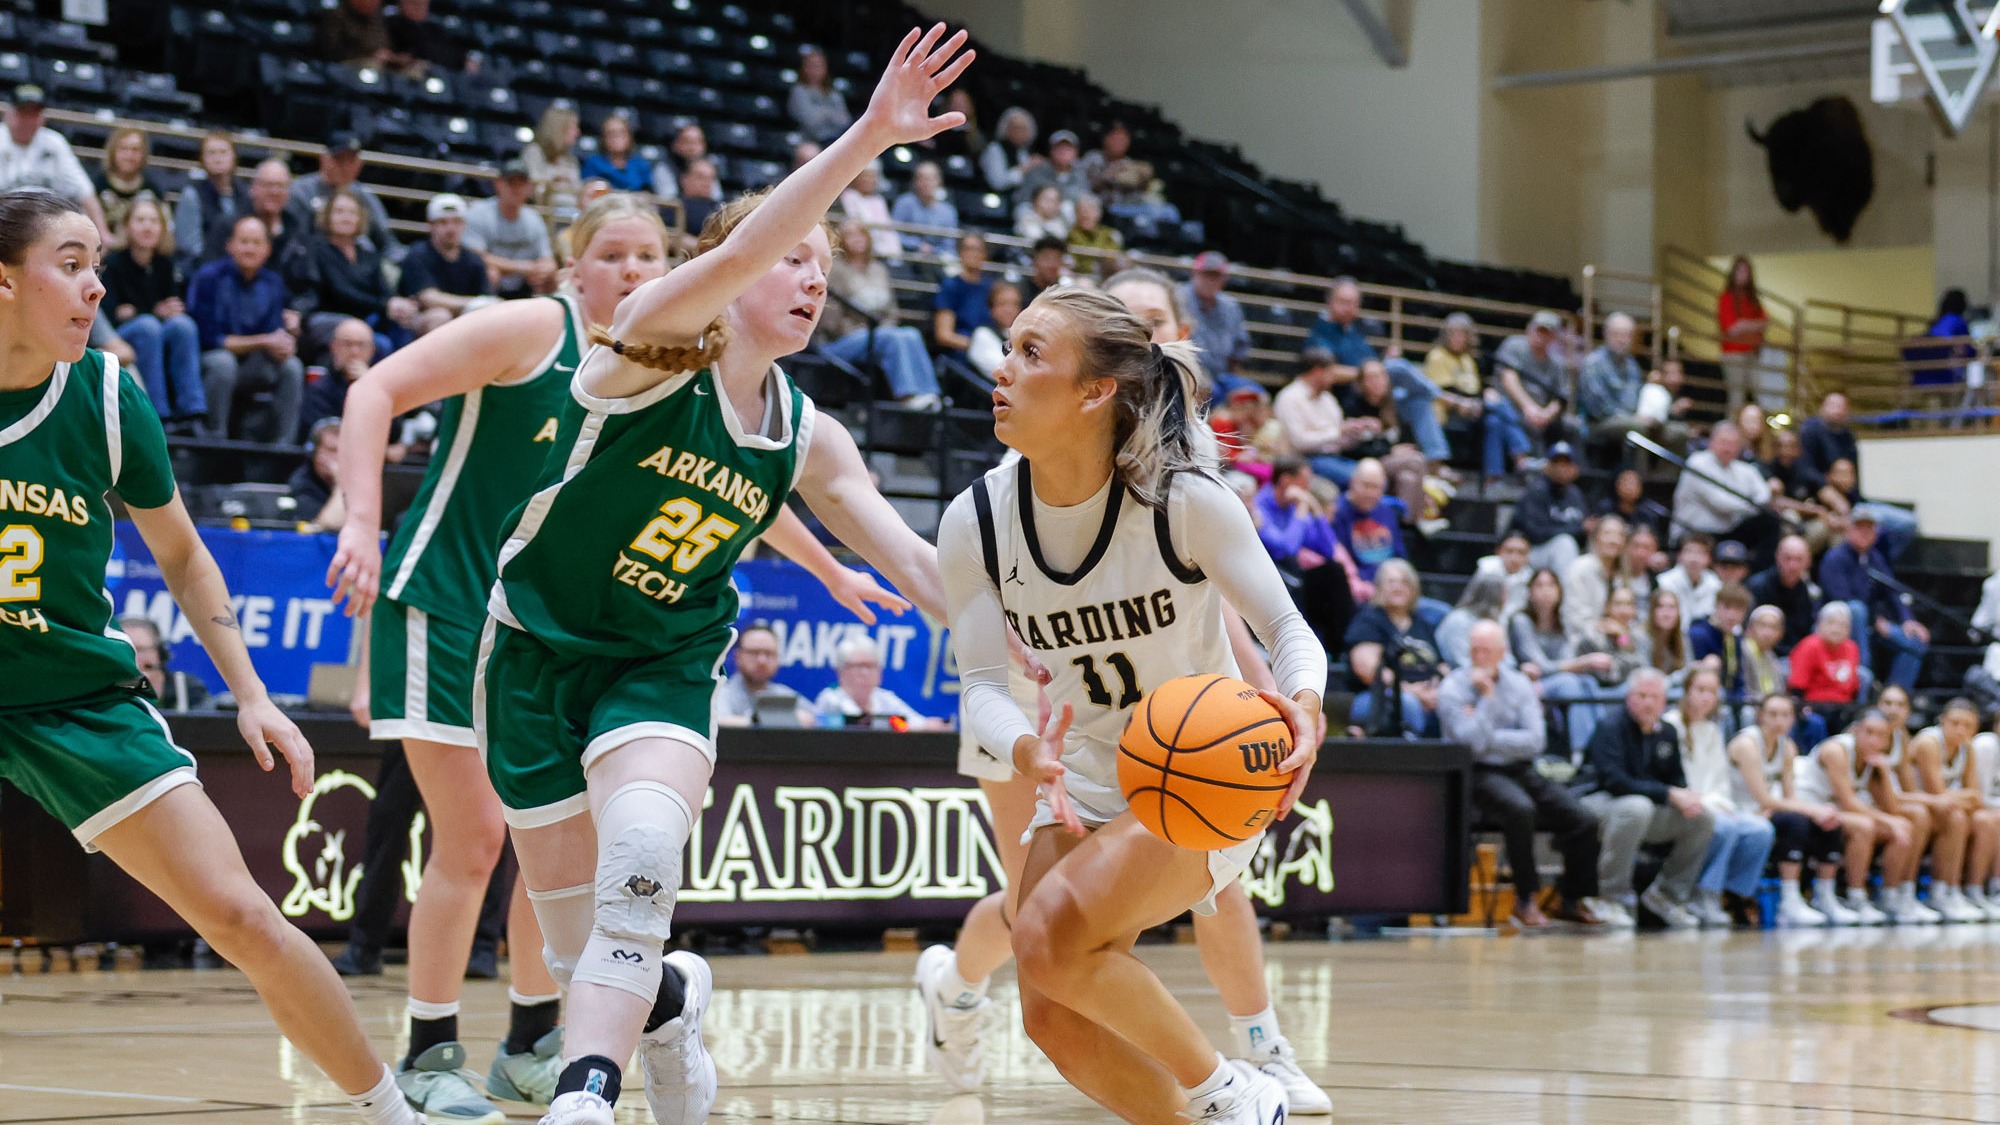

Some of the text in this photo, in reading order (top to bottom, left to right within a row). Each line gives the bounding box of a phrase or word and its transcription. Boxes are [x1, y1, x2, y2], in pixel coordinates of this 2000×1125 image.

[0, 479, 90, 526] NSAS
[629, 497, 740, 573] 25
[0, 524, 44, 602] 2
[613, 551, 688, 604] TECH
[282, 597, 335, 649] IT
[876, 623, 916, 671] IT
[1069, 651, 1144, 711] 11
[1238, 738, 1290, 774] Wil
